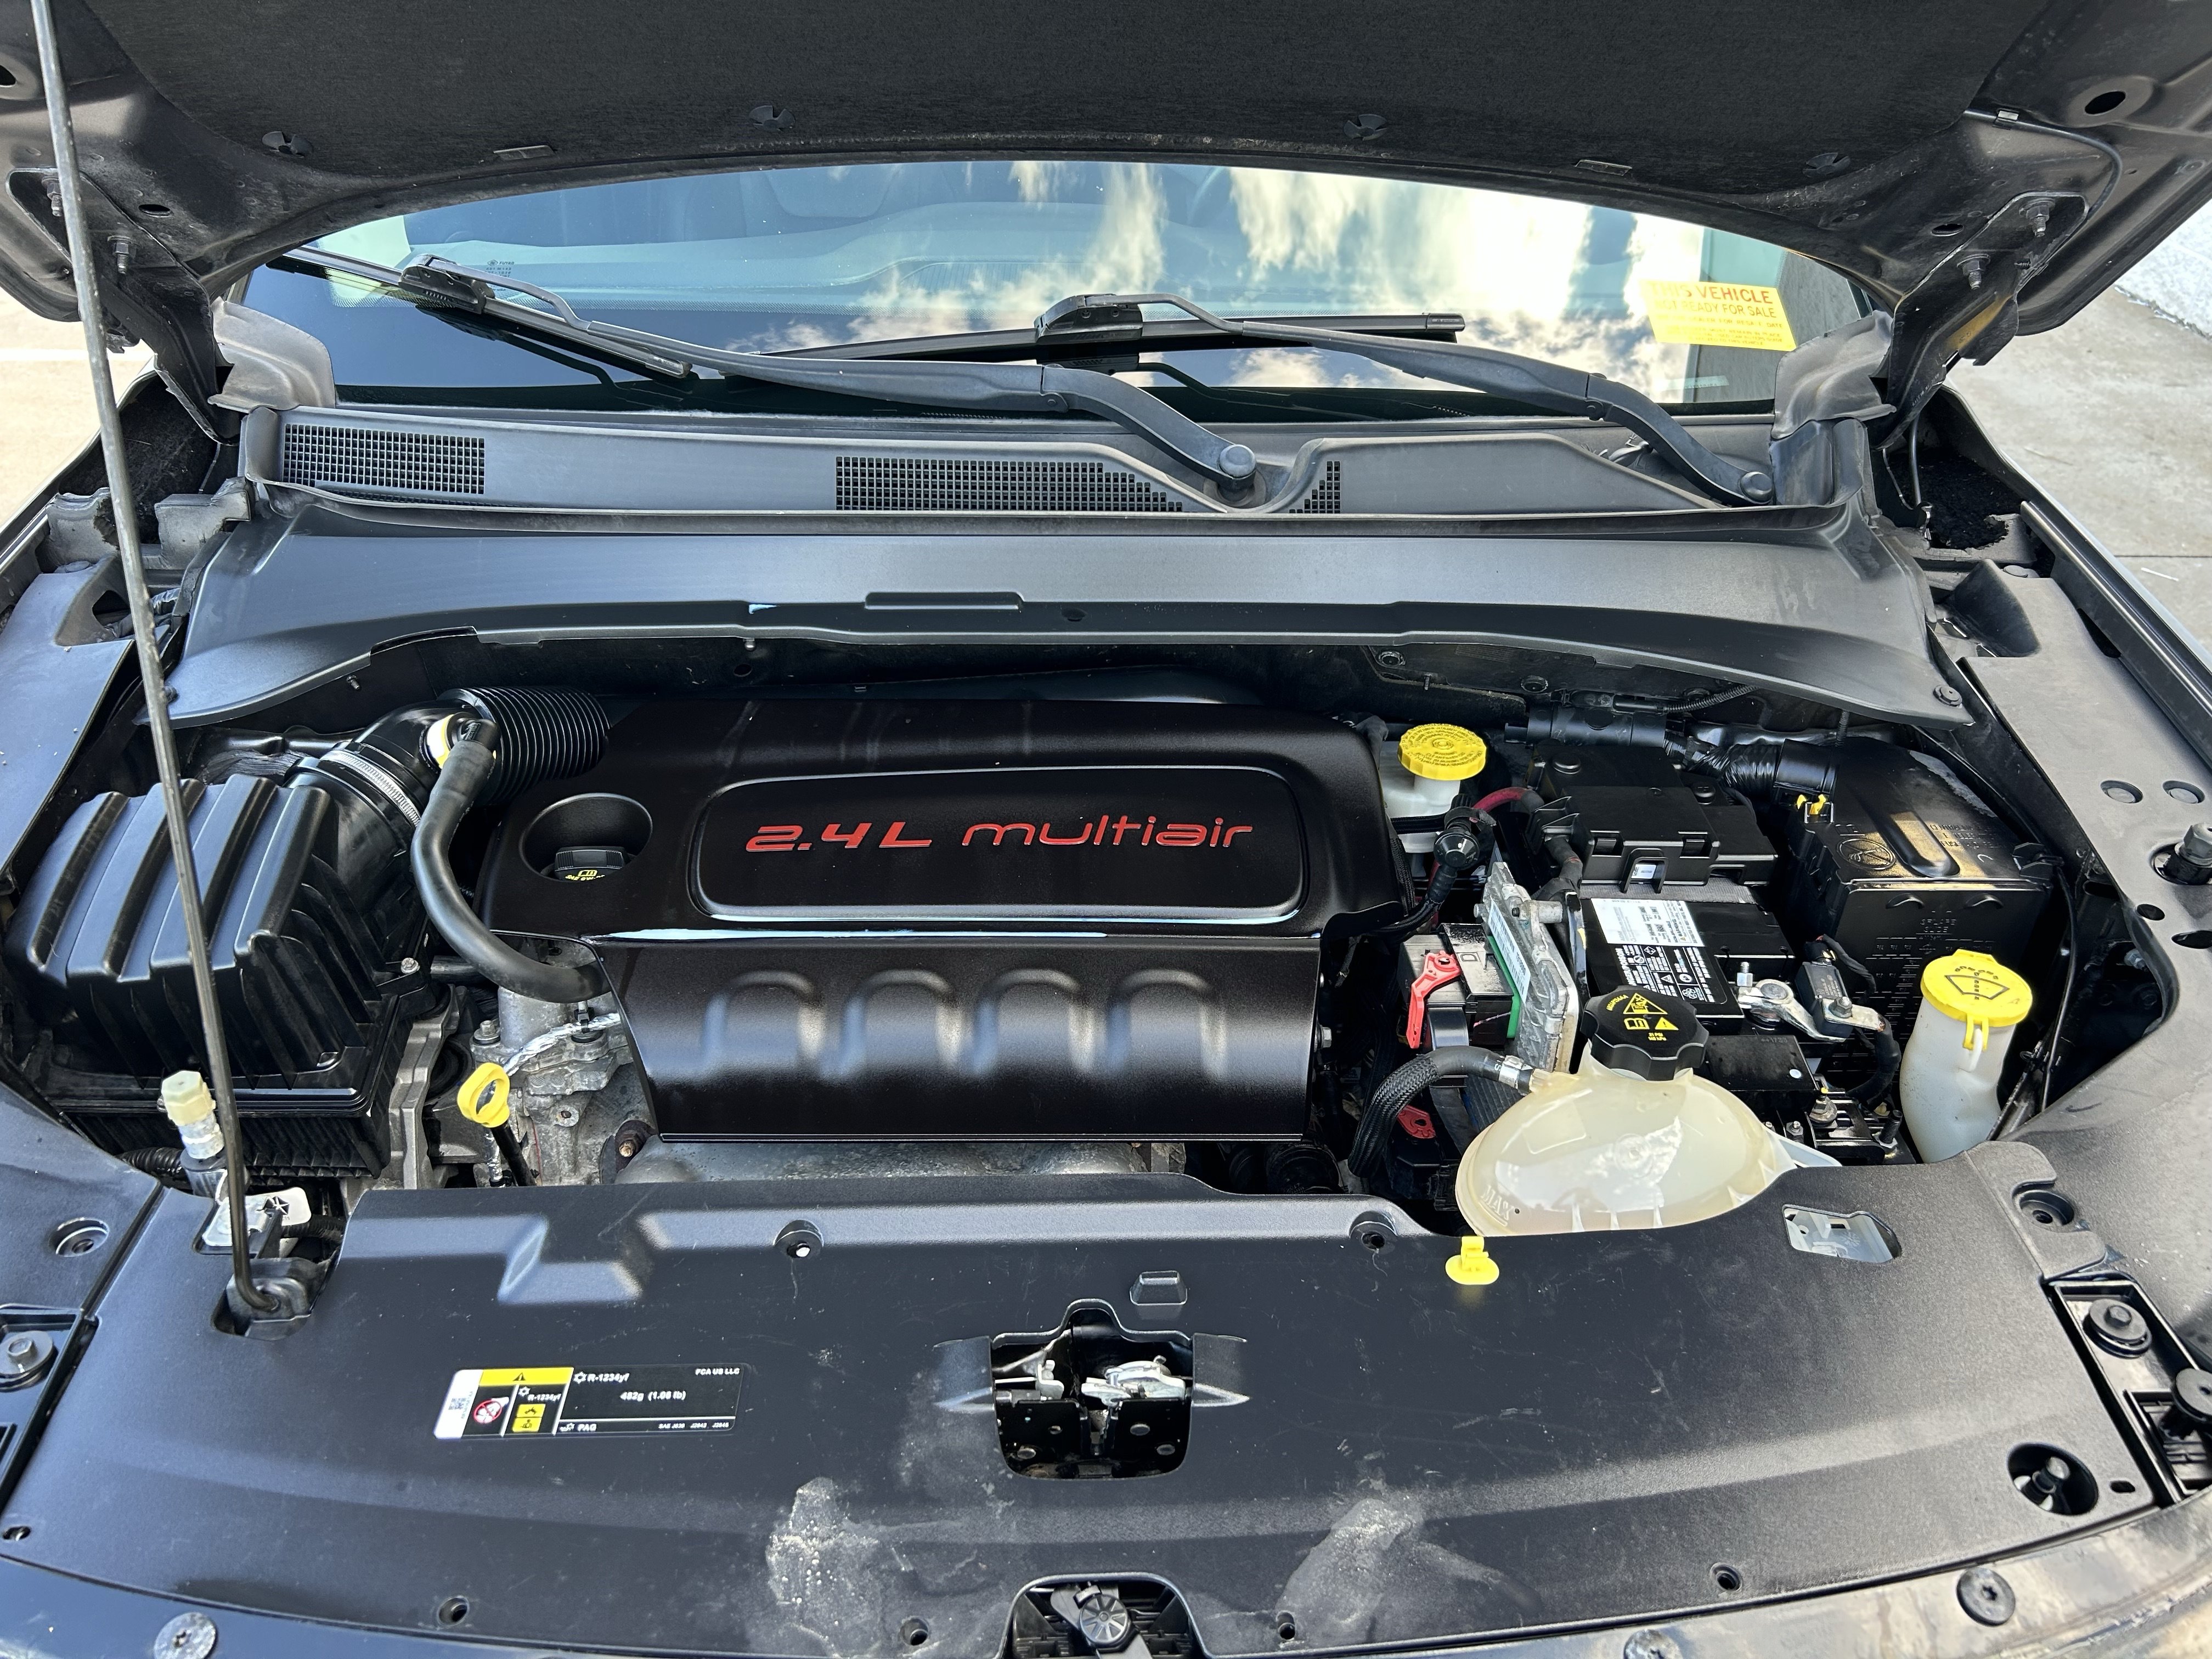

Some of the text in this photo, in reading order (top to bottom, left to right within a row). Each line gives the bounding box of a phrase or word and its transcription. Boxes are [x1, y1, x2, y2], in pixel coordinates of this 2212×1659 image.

[1695, 285, 1773, 304] VEHICLE
[1681, 300, 1718, 313] READY
[1722, 304, 1745, 315] FOR
[1748, 306, 1777, 318] SALE
[961, 815, 1253, 847] multiair
[1480, 1184, 1514, 1221] MAX
[587, 1373, 629, 1383] R-1234yf
[577, 1423, 597, 1431] PAG
